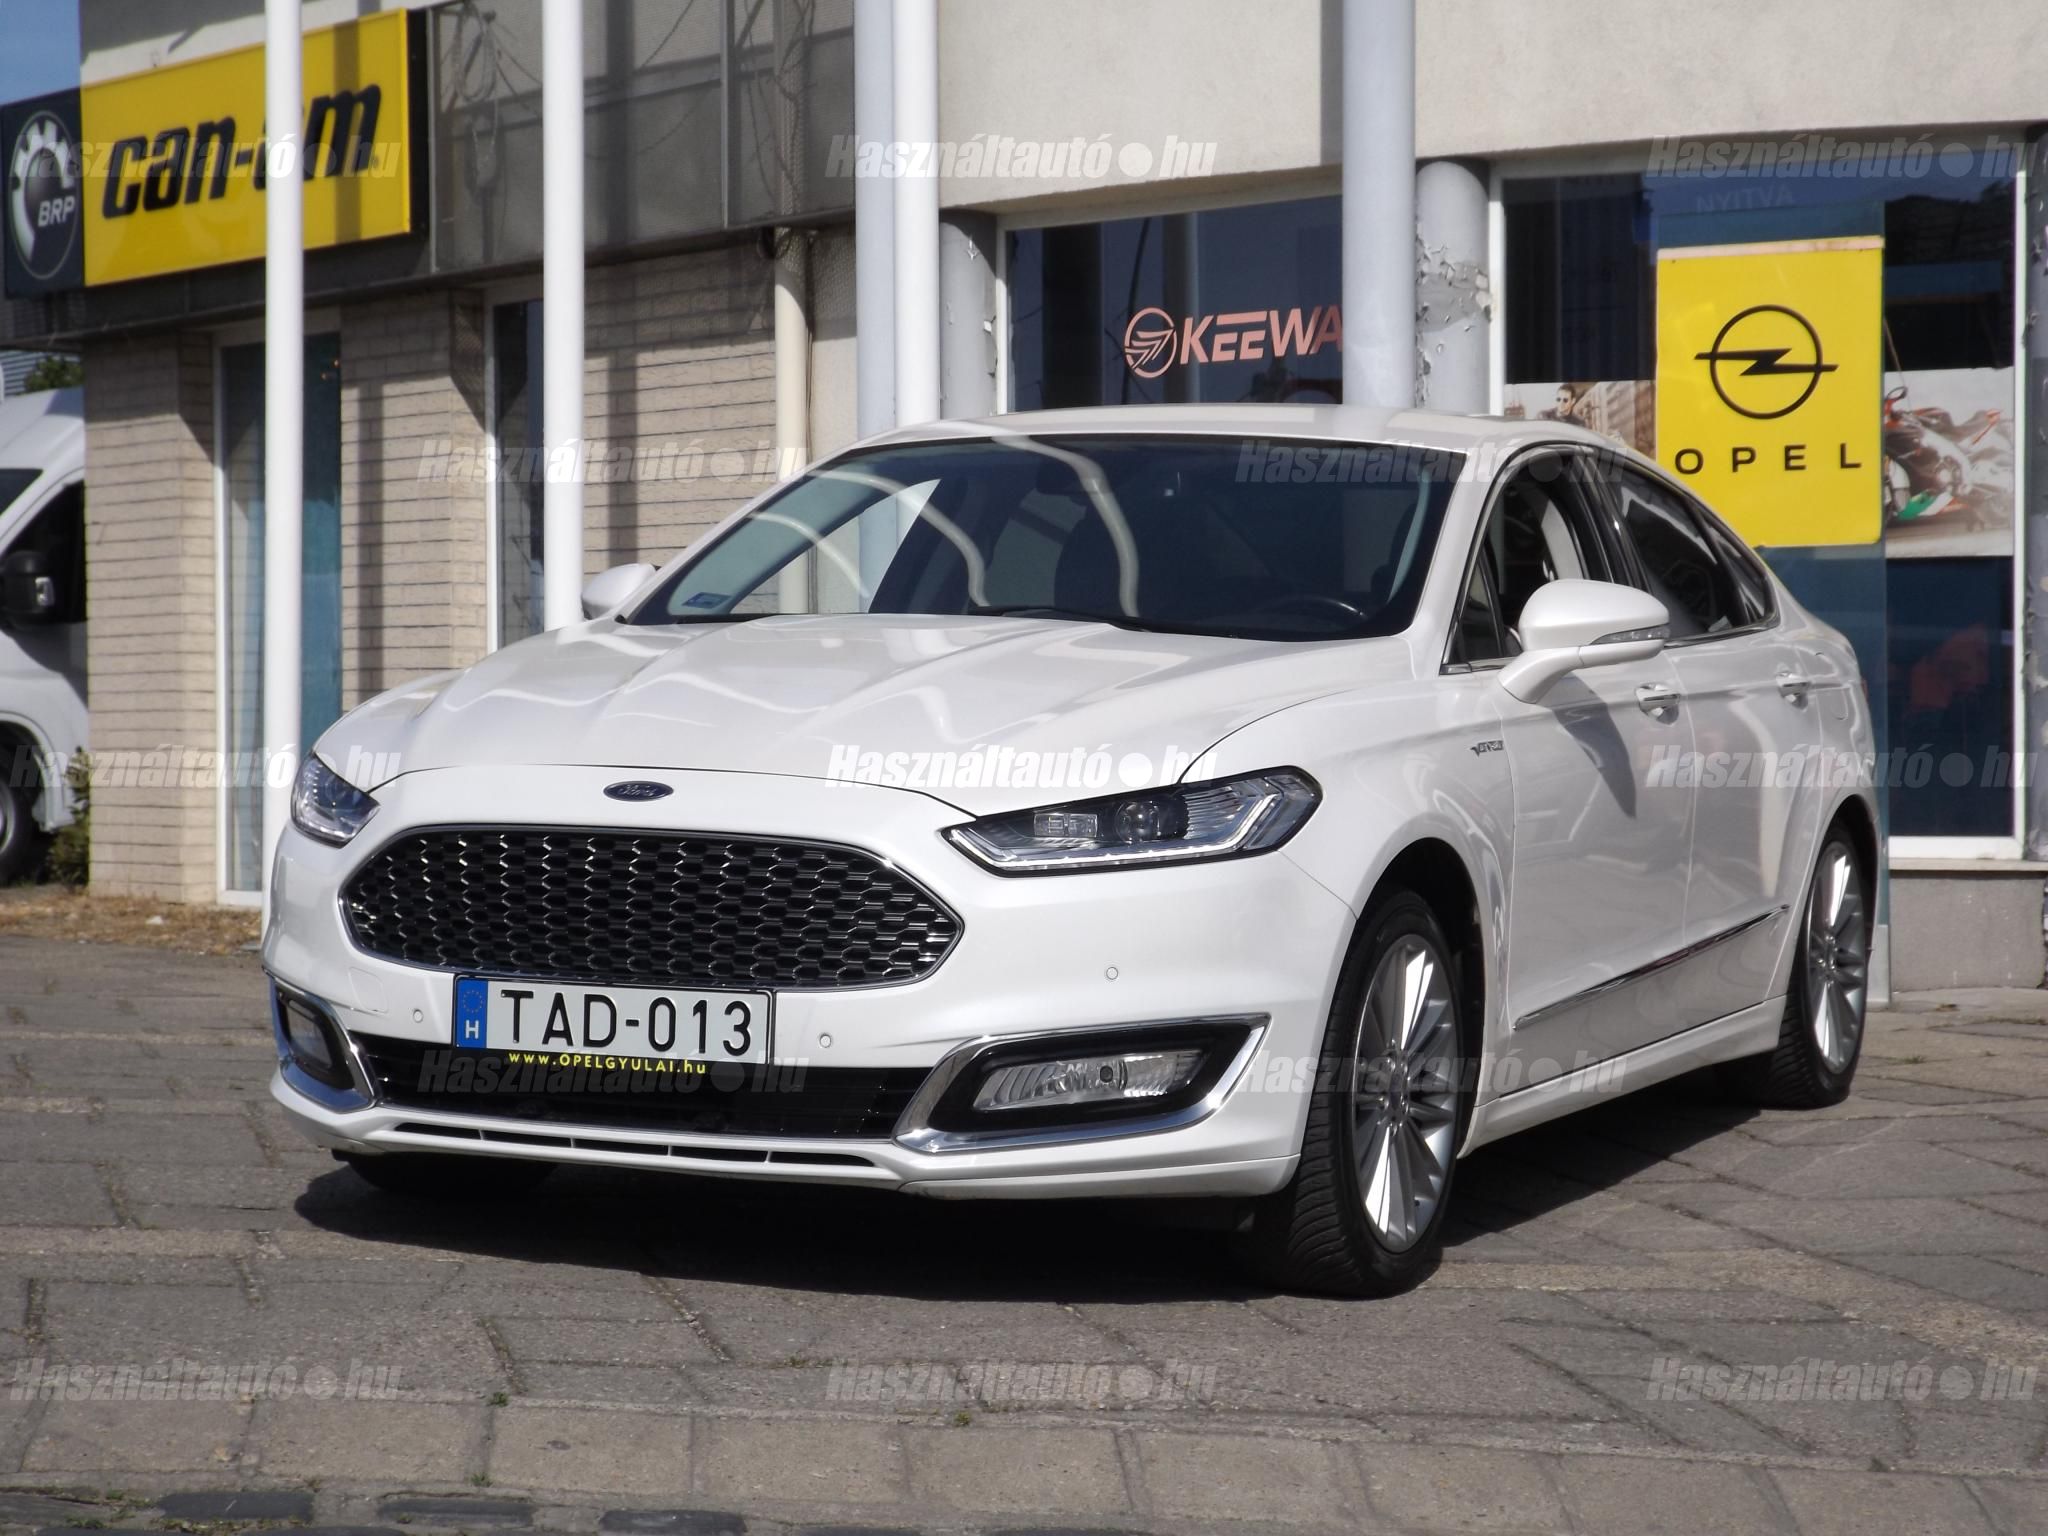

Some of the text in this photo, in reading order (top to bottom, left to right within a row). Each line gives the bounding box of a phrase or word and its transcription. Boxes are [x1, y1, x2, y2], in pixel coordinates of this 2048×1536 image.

[102, 84, 381, 219] can-m
[38, 195, 76, 227] BRP
[1696, 184, 1793, 213] NYITVA
[1674, 443, 1862, 475] OPEL
[464, 1019, 480, 1040] H
[500, 988, 752, 1057] TAD-013
[508, 1052, 707, 1075] www.OPELGYULAI.hu
